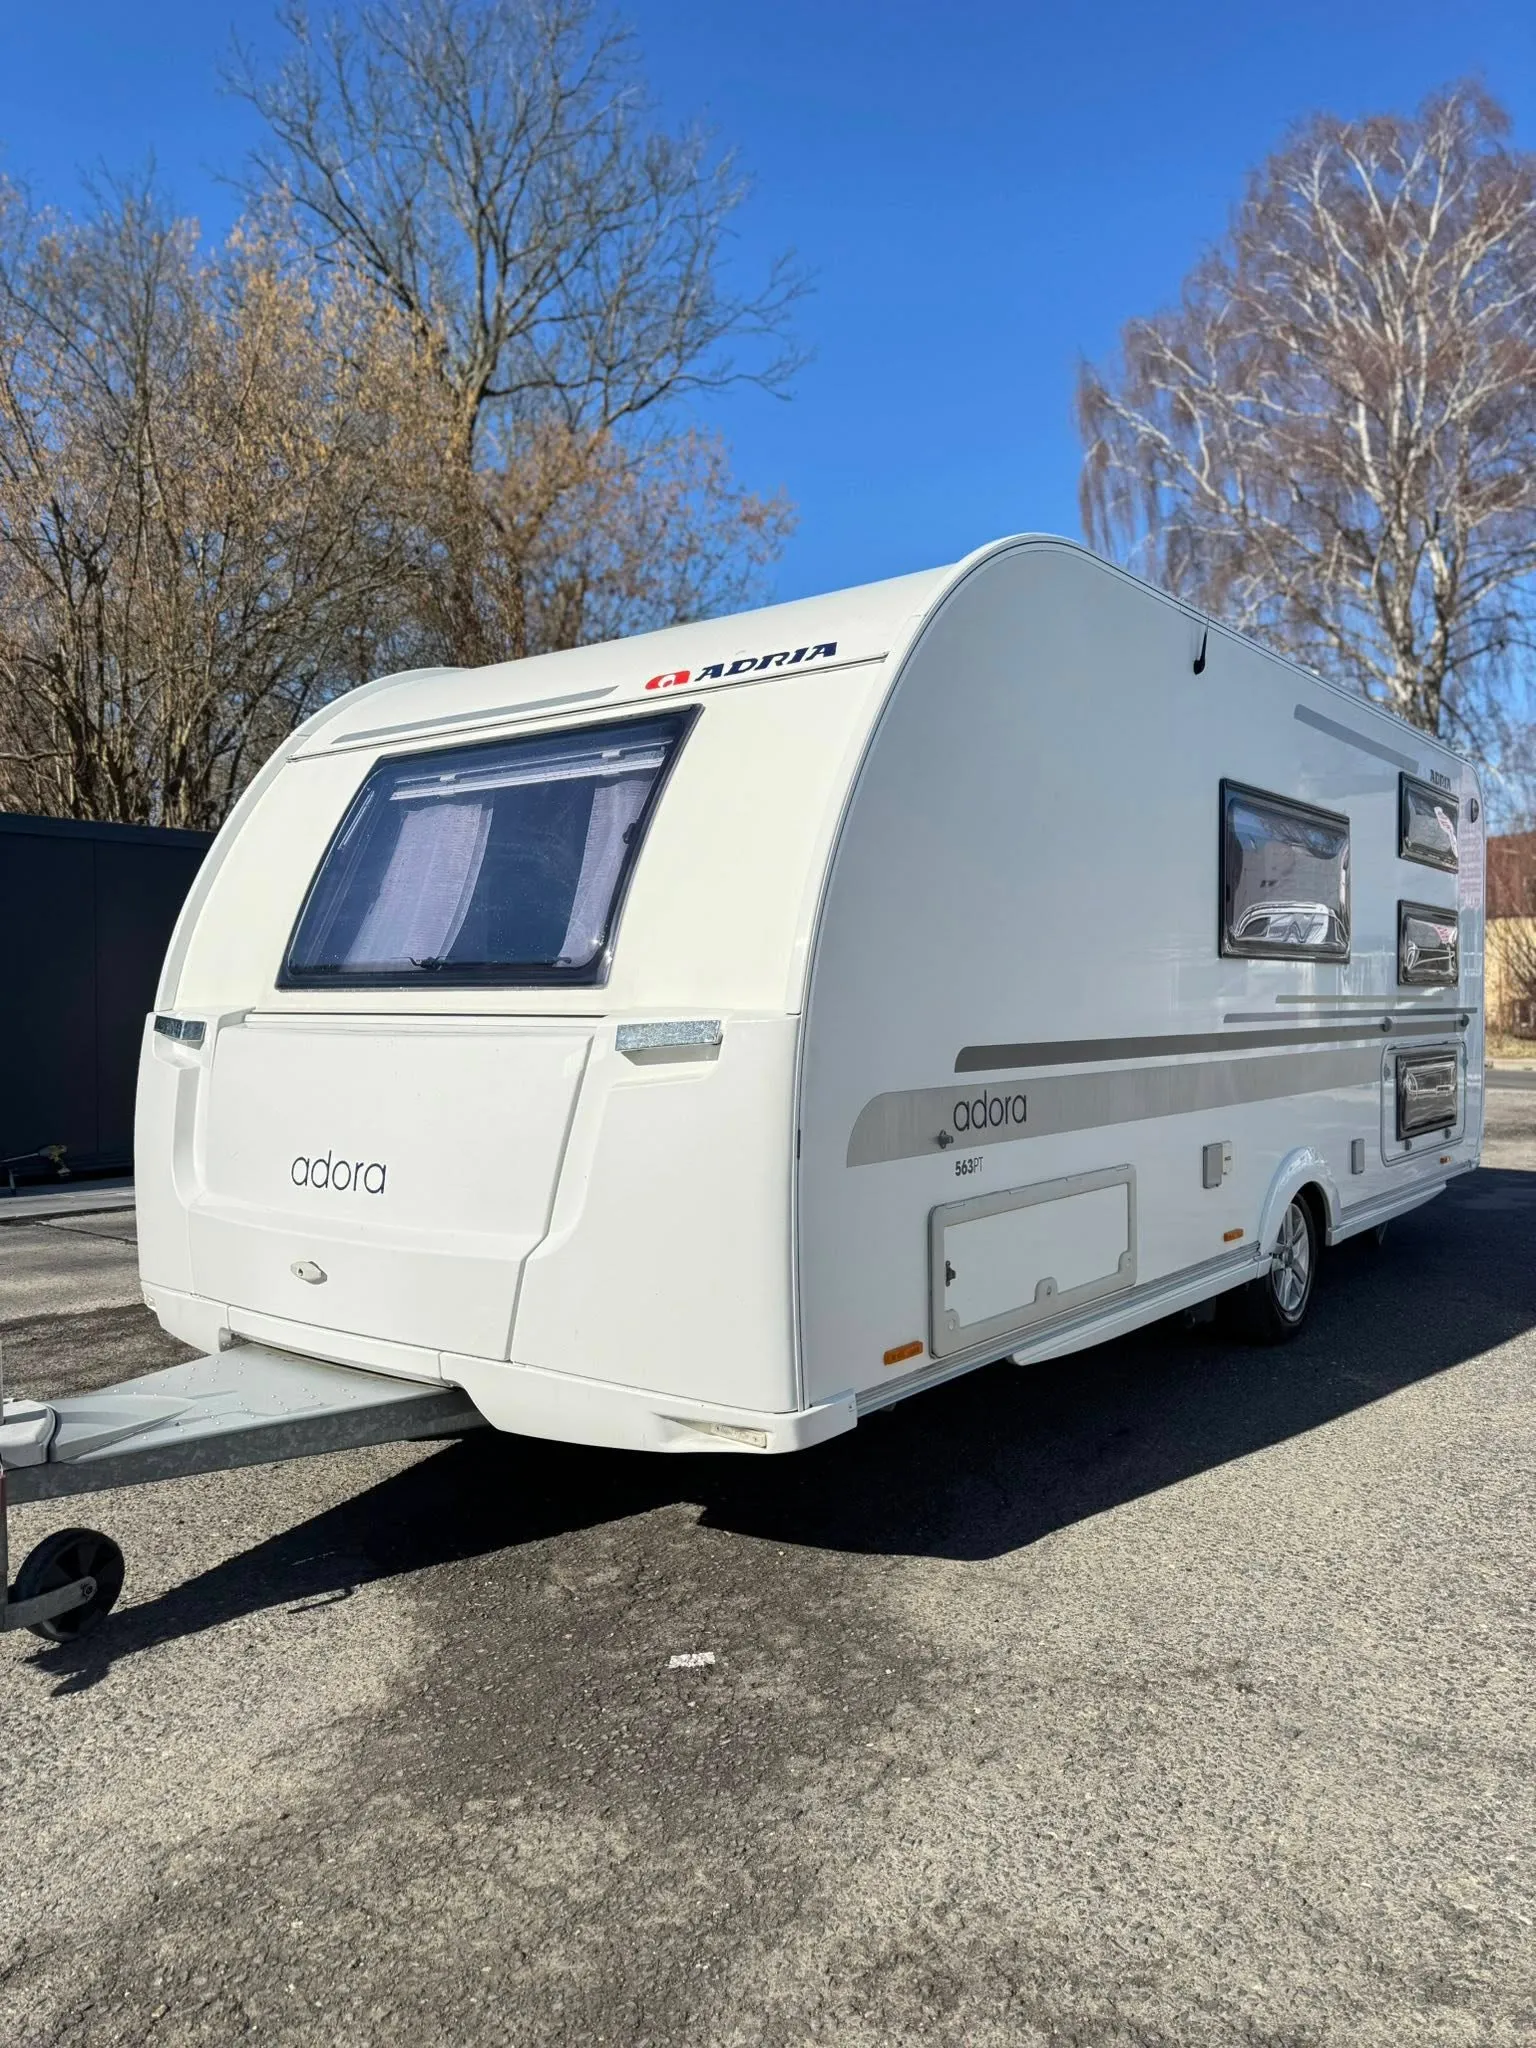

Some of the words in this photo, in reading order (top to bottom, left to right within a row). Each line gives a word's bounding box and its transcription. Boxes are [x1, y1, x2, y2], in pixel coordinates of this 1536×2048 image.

[694, 641, 838, 682] ADRIA
[953, 1089, 1027, 1132] adora
[291, 1149, 387, 1194] adora
